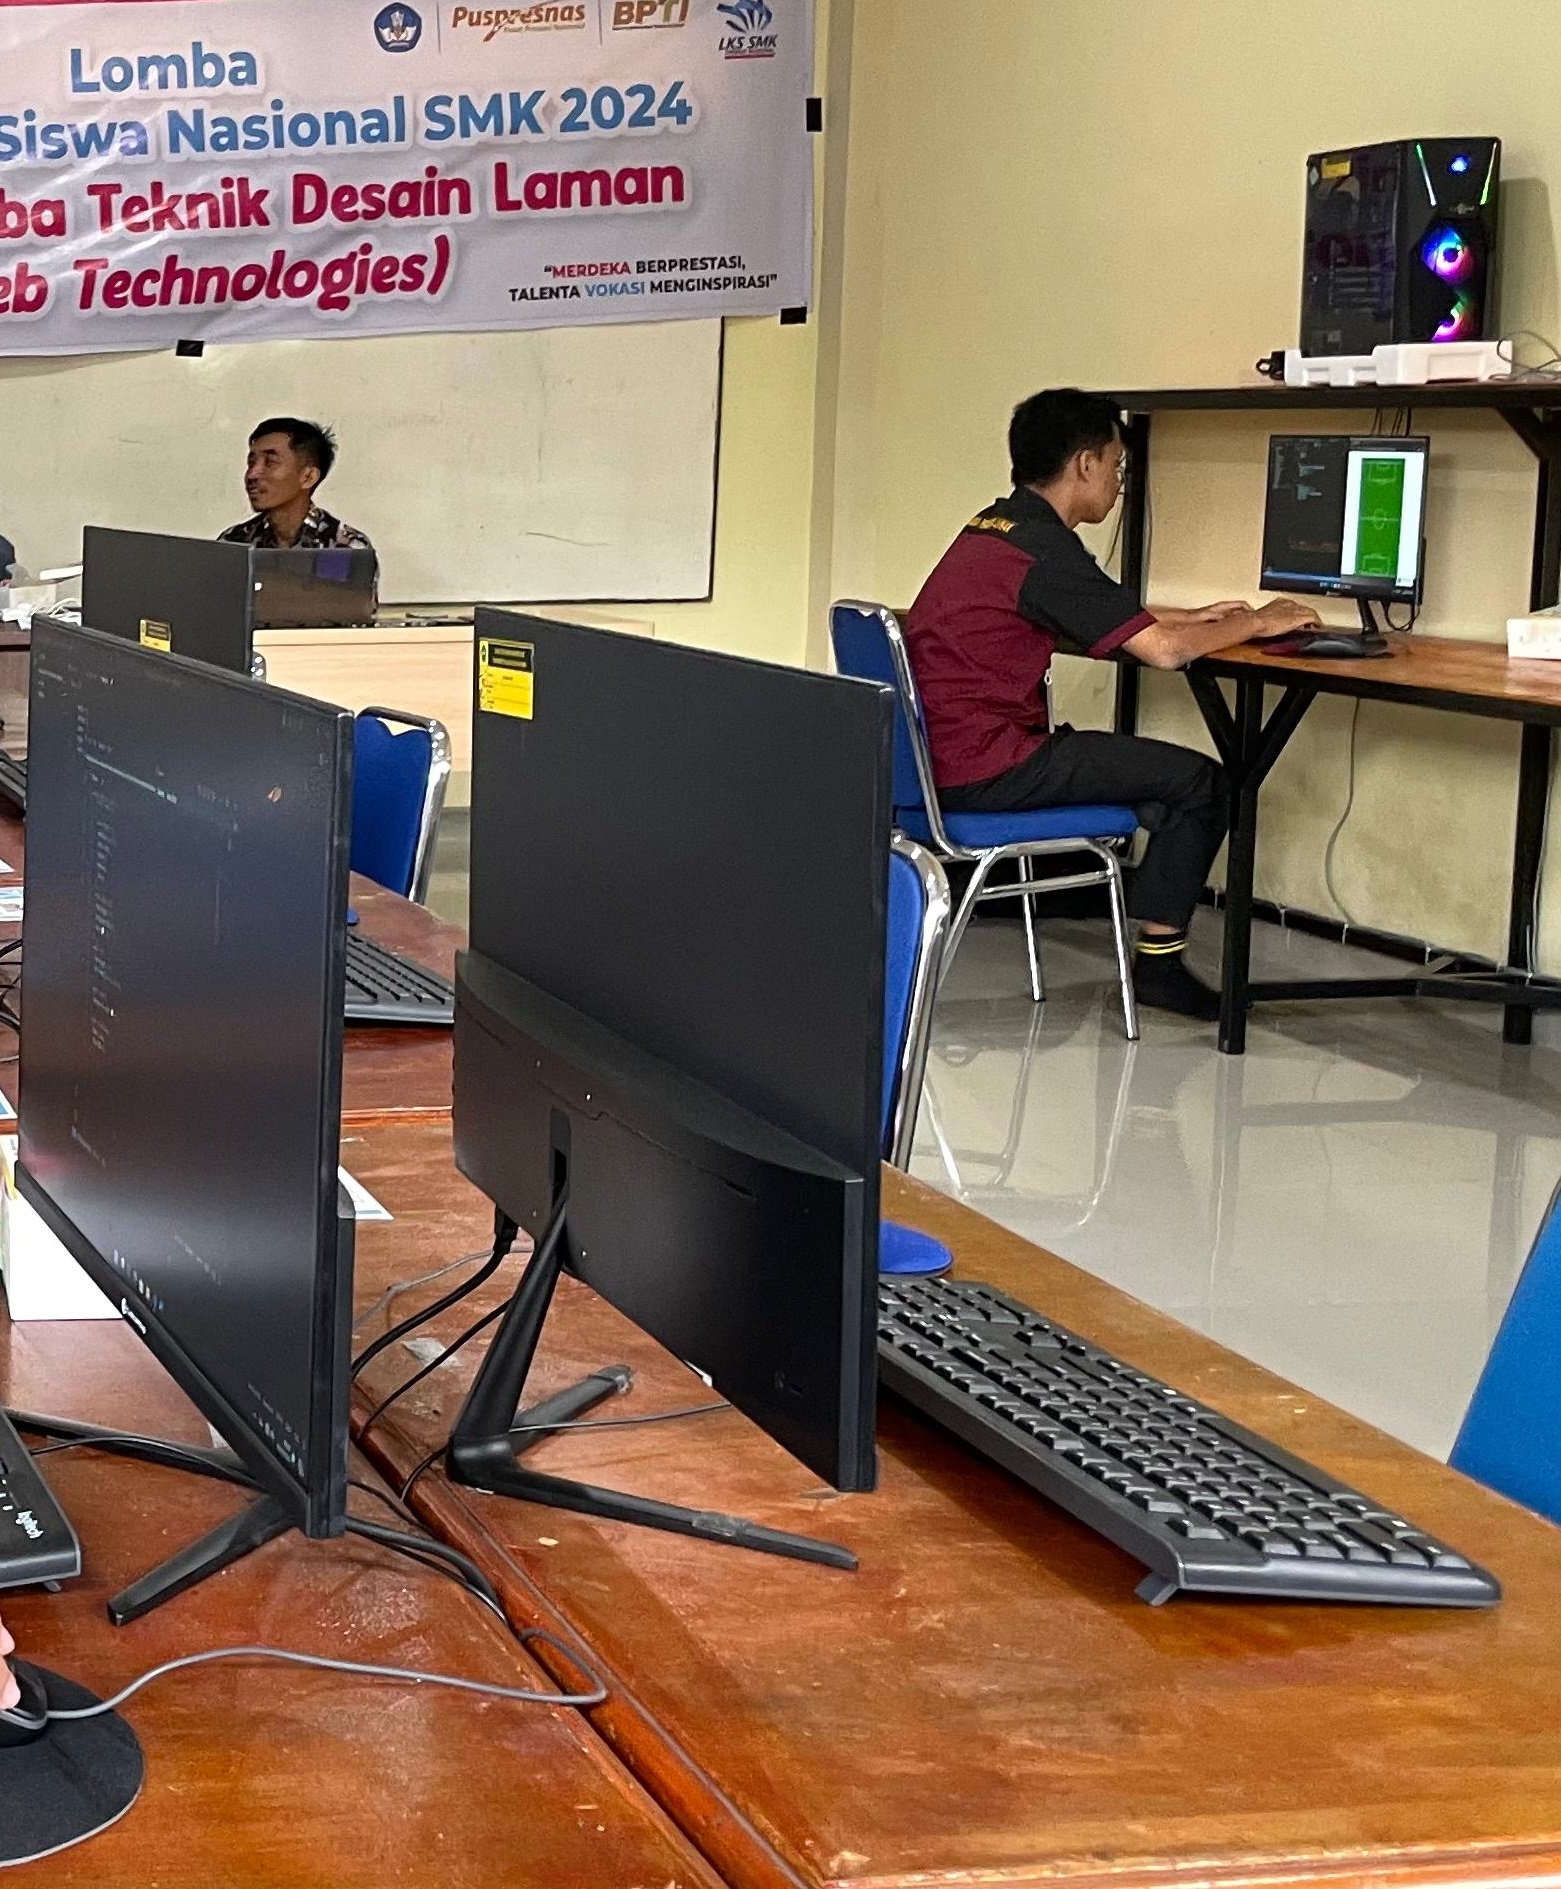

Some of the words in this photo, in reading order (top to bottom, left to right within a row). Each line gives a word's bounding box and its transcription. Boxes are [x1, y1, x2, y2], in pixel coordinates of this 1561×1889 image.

[452, 4, 586, 42] Puspresnas
[614, 0, 689, 25] BPTI
[719, 37, 745, 50] LKS
[746, 35, 778, 49] SMK
[70, 41, 258, 93] Lomba
[167, 96, 405, 154] Nasional
[424, 90, 545, 142] SMK
[559, 81, 693, 133] 2024
[87, 176, 270, 233] Teknik
[292, 165, 472, 225] Desain
[494, 161, 685, 212] Laman
[73, 234, 451, 311] Technologies)
[636, 256, 746, 274] BERPRESTASI,
[509, 285, 581, 301] TALENTA
[585, 282, 645, 298] VOKASI
